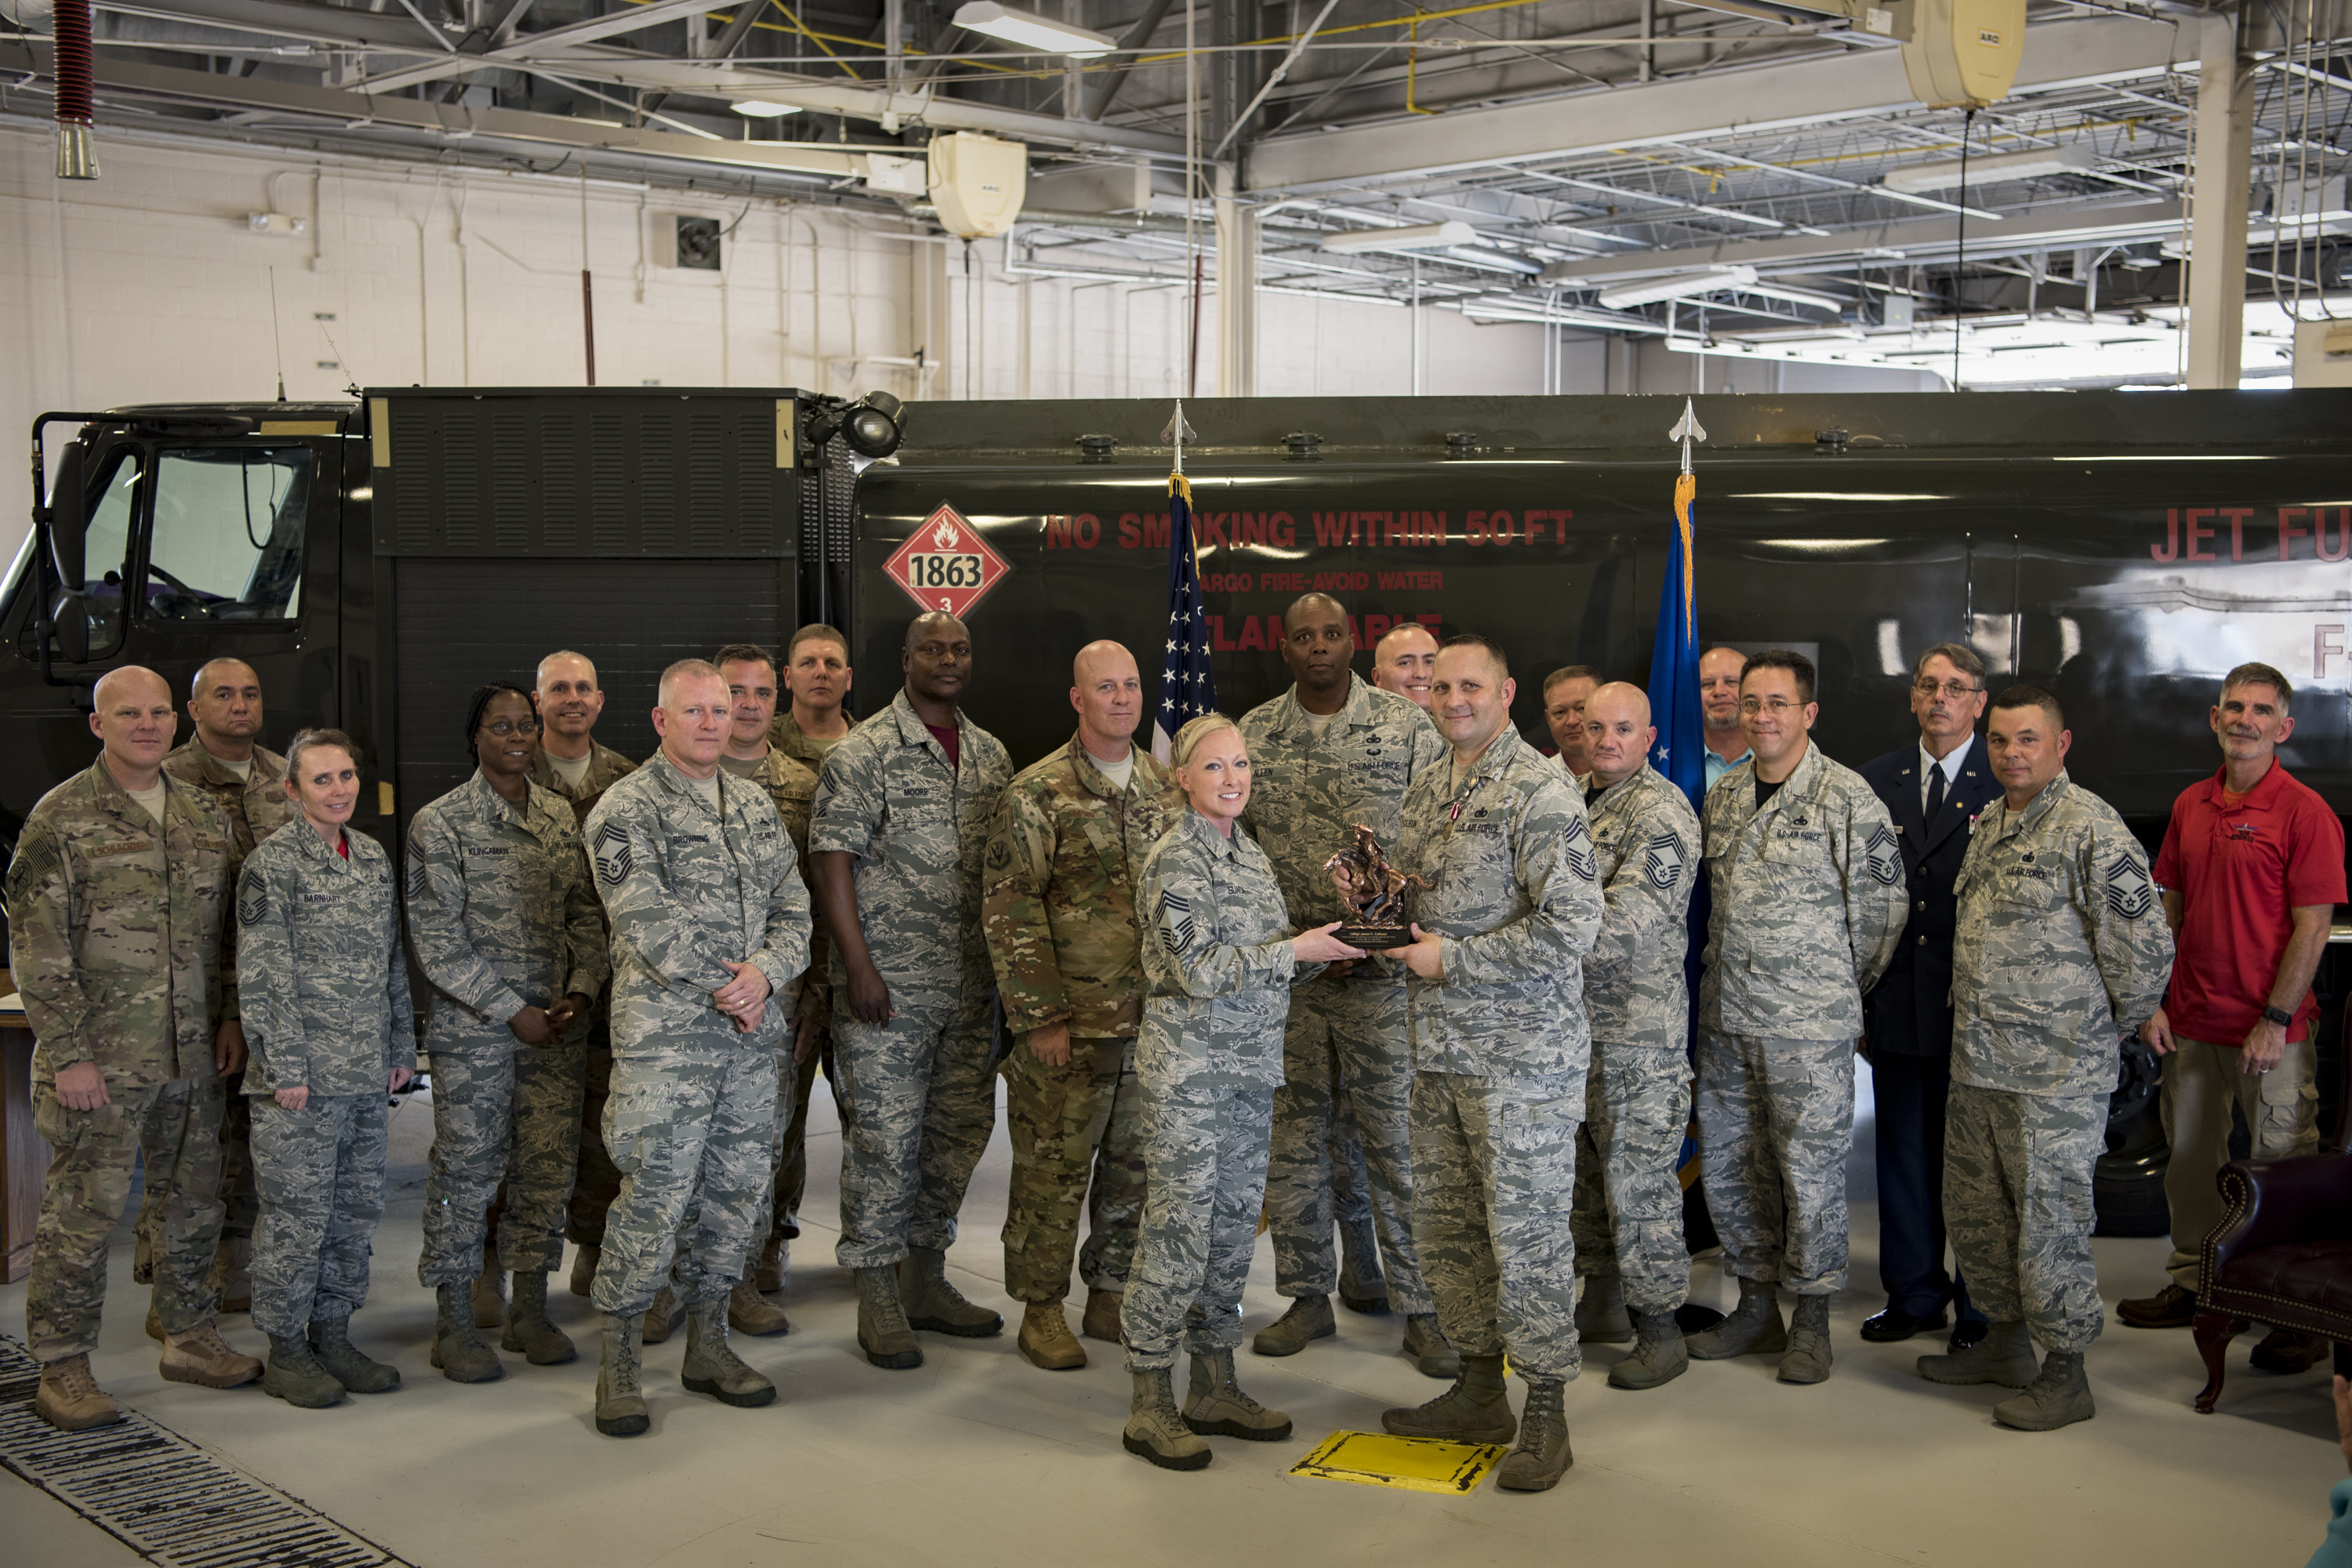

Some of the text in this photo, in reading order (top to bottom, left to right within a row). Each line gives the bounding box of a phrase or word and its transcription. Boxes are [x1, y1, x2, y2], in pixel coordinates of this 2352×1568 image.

[1047, 513, 1101, 549] NO
[1312, 510, 1447, 546] WITHIN
[1465, 510, 1515, 546] 50
[1524, 509, 1573, 546] FT
[2151, 508, 2253, 562] JET
[911, 555, 981, 587] 1863
[1200, 570, 1443, 592] ARGO FIRE-AVOID WATER
[940, 597, 952, 613] 3
[1206, 614, 1442, 651] LAMAB
[2314, 624, 2352, 679] F
[1377, 761, 1400, 770] FORCE
[904, 788, 928, 797] MOORE
[1477, 824, 1499, 834] FORCE
[673, 834, 710, 844] BROWNING
[1801, 832, 1821, 841] FORCE
[2026, 869, 2047, 880] FORCE
[303, 894, 341, 903] BARNHART
